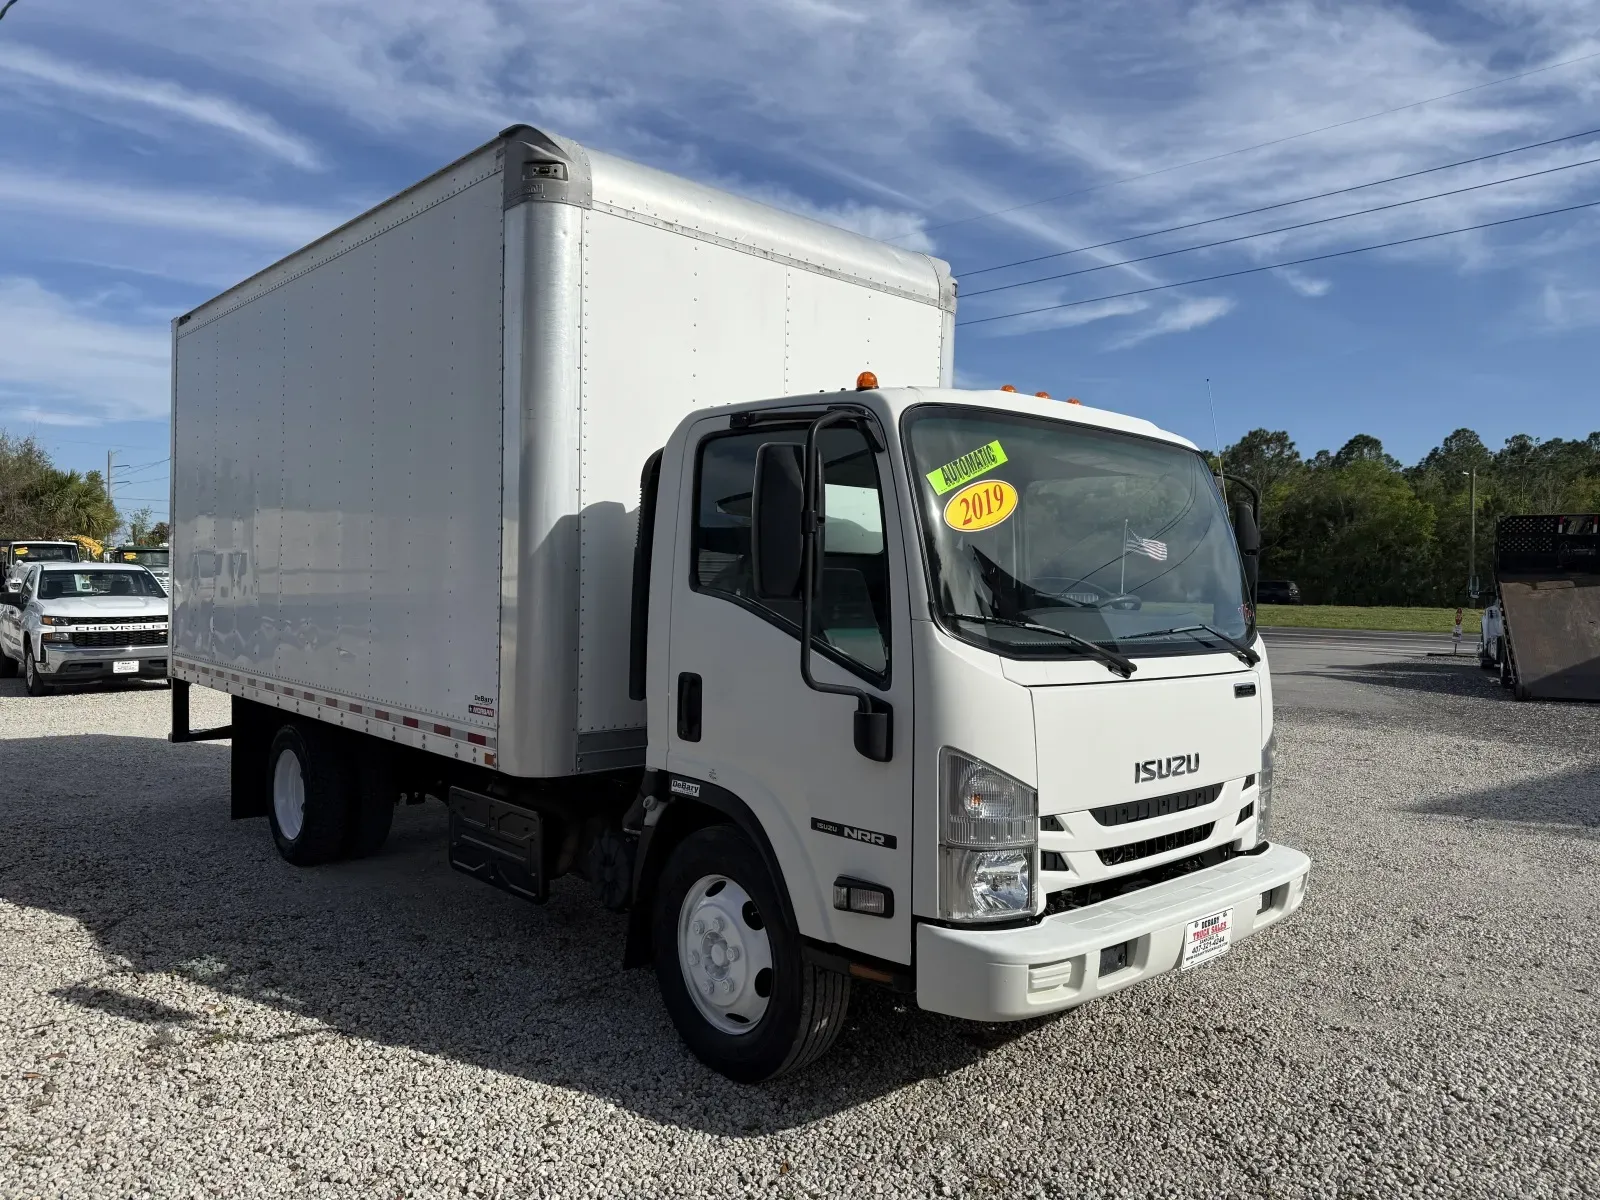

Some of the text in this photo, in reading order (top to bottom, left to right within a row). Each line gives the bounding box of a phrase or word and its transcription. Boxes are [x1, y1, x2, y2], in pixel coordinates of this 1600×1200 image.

[940, 444, 997, 486] AUTOMATIC
[959, 484, 1004, 526] 2019
[75, 623, 168, 632] CHEVROLET
[474, 694, 494, 705] DeBary
[472, 706, 494, 717] MORGAN
[1134, 752, 1200, 784] ISUZU
[672, 780, 699, 794] DeBary
[816, 822, 885, 846] ISUZU NRR
[1192, 921, 1227, 941] TRUCK SALES
[1201, 916, 1220, 929] DEBARY
